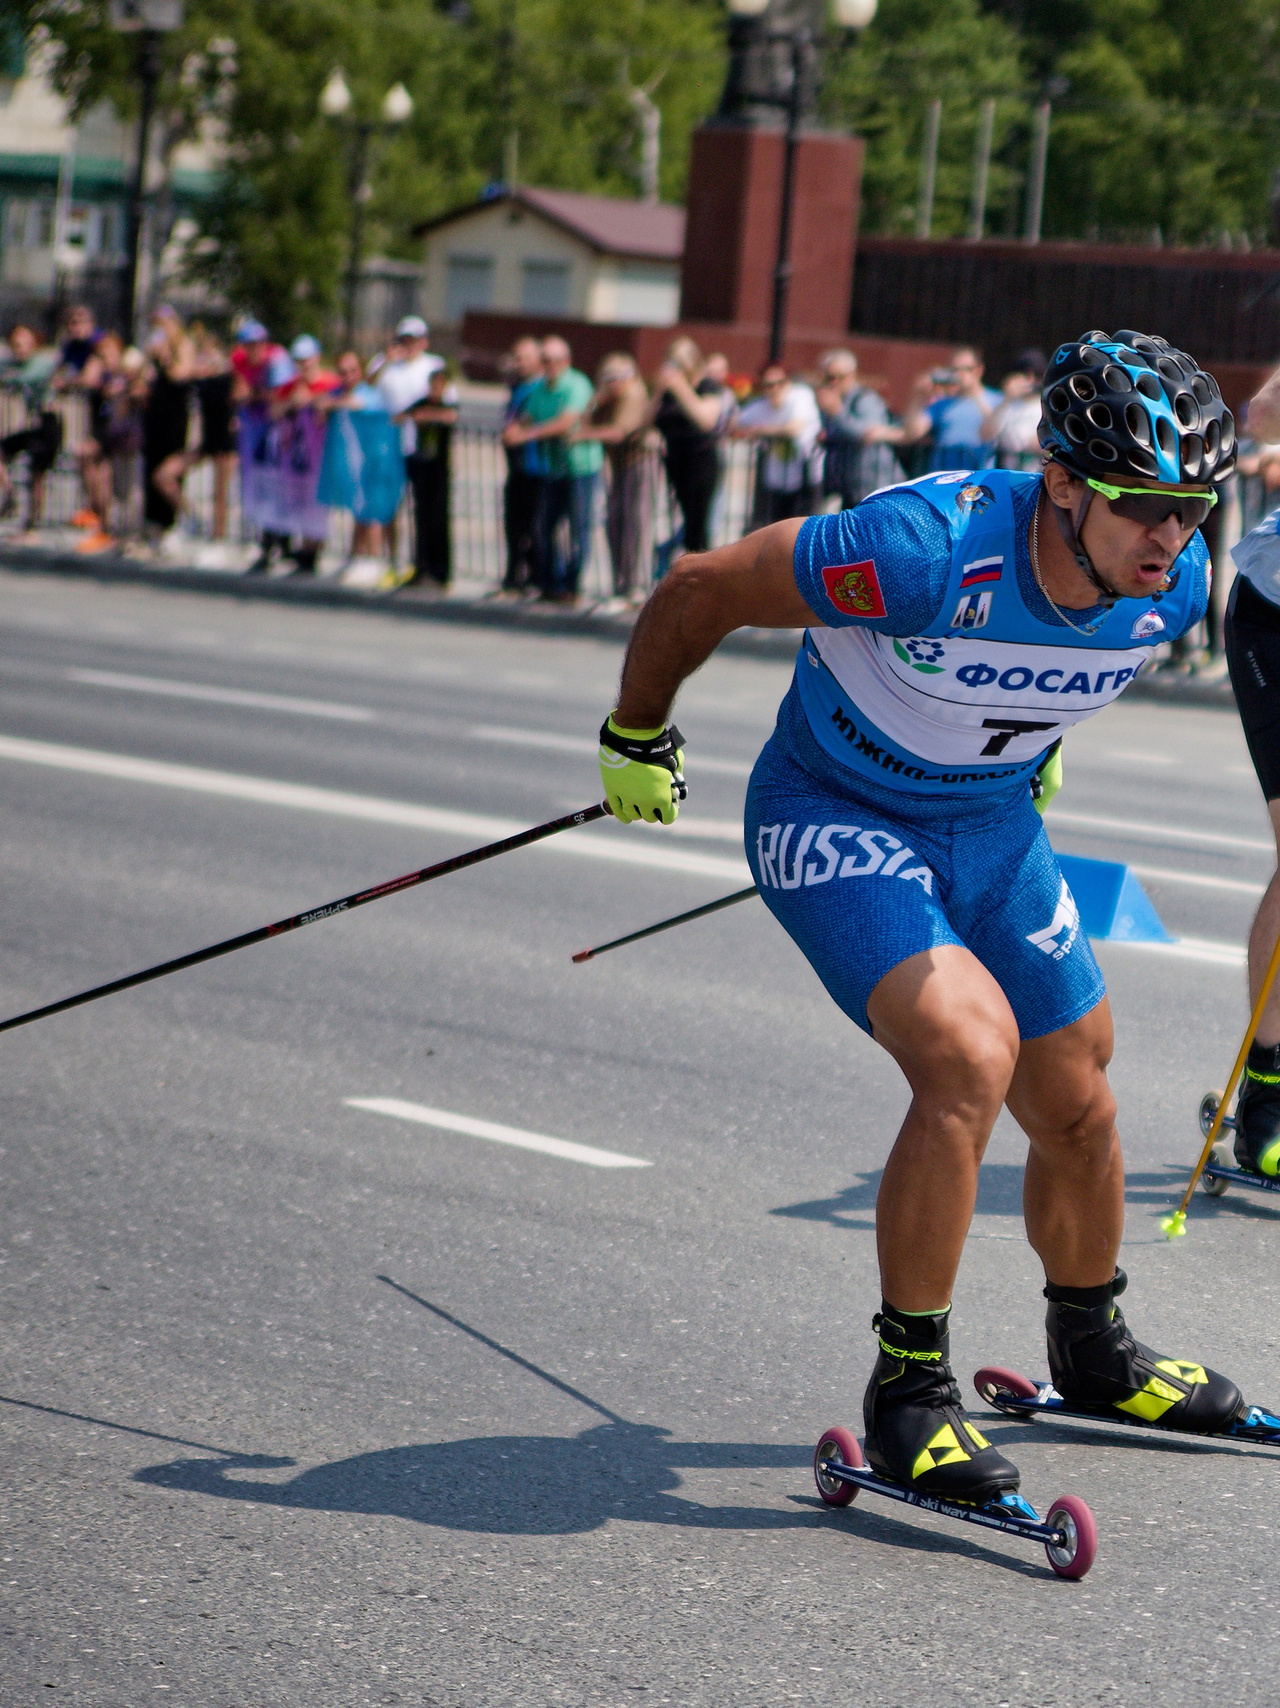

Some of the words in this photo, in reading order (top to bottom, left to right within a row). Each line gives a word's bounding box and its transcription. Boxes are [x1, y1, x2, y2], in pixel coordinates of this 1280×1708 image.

[757, 823, 936, 897] RUSSIA
[300, 901, 348, 925] SPHERE
[940, 1502, 967, 1519] way
